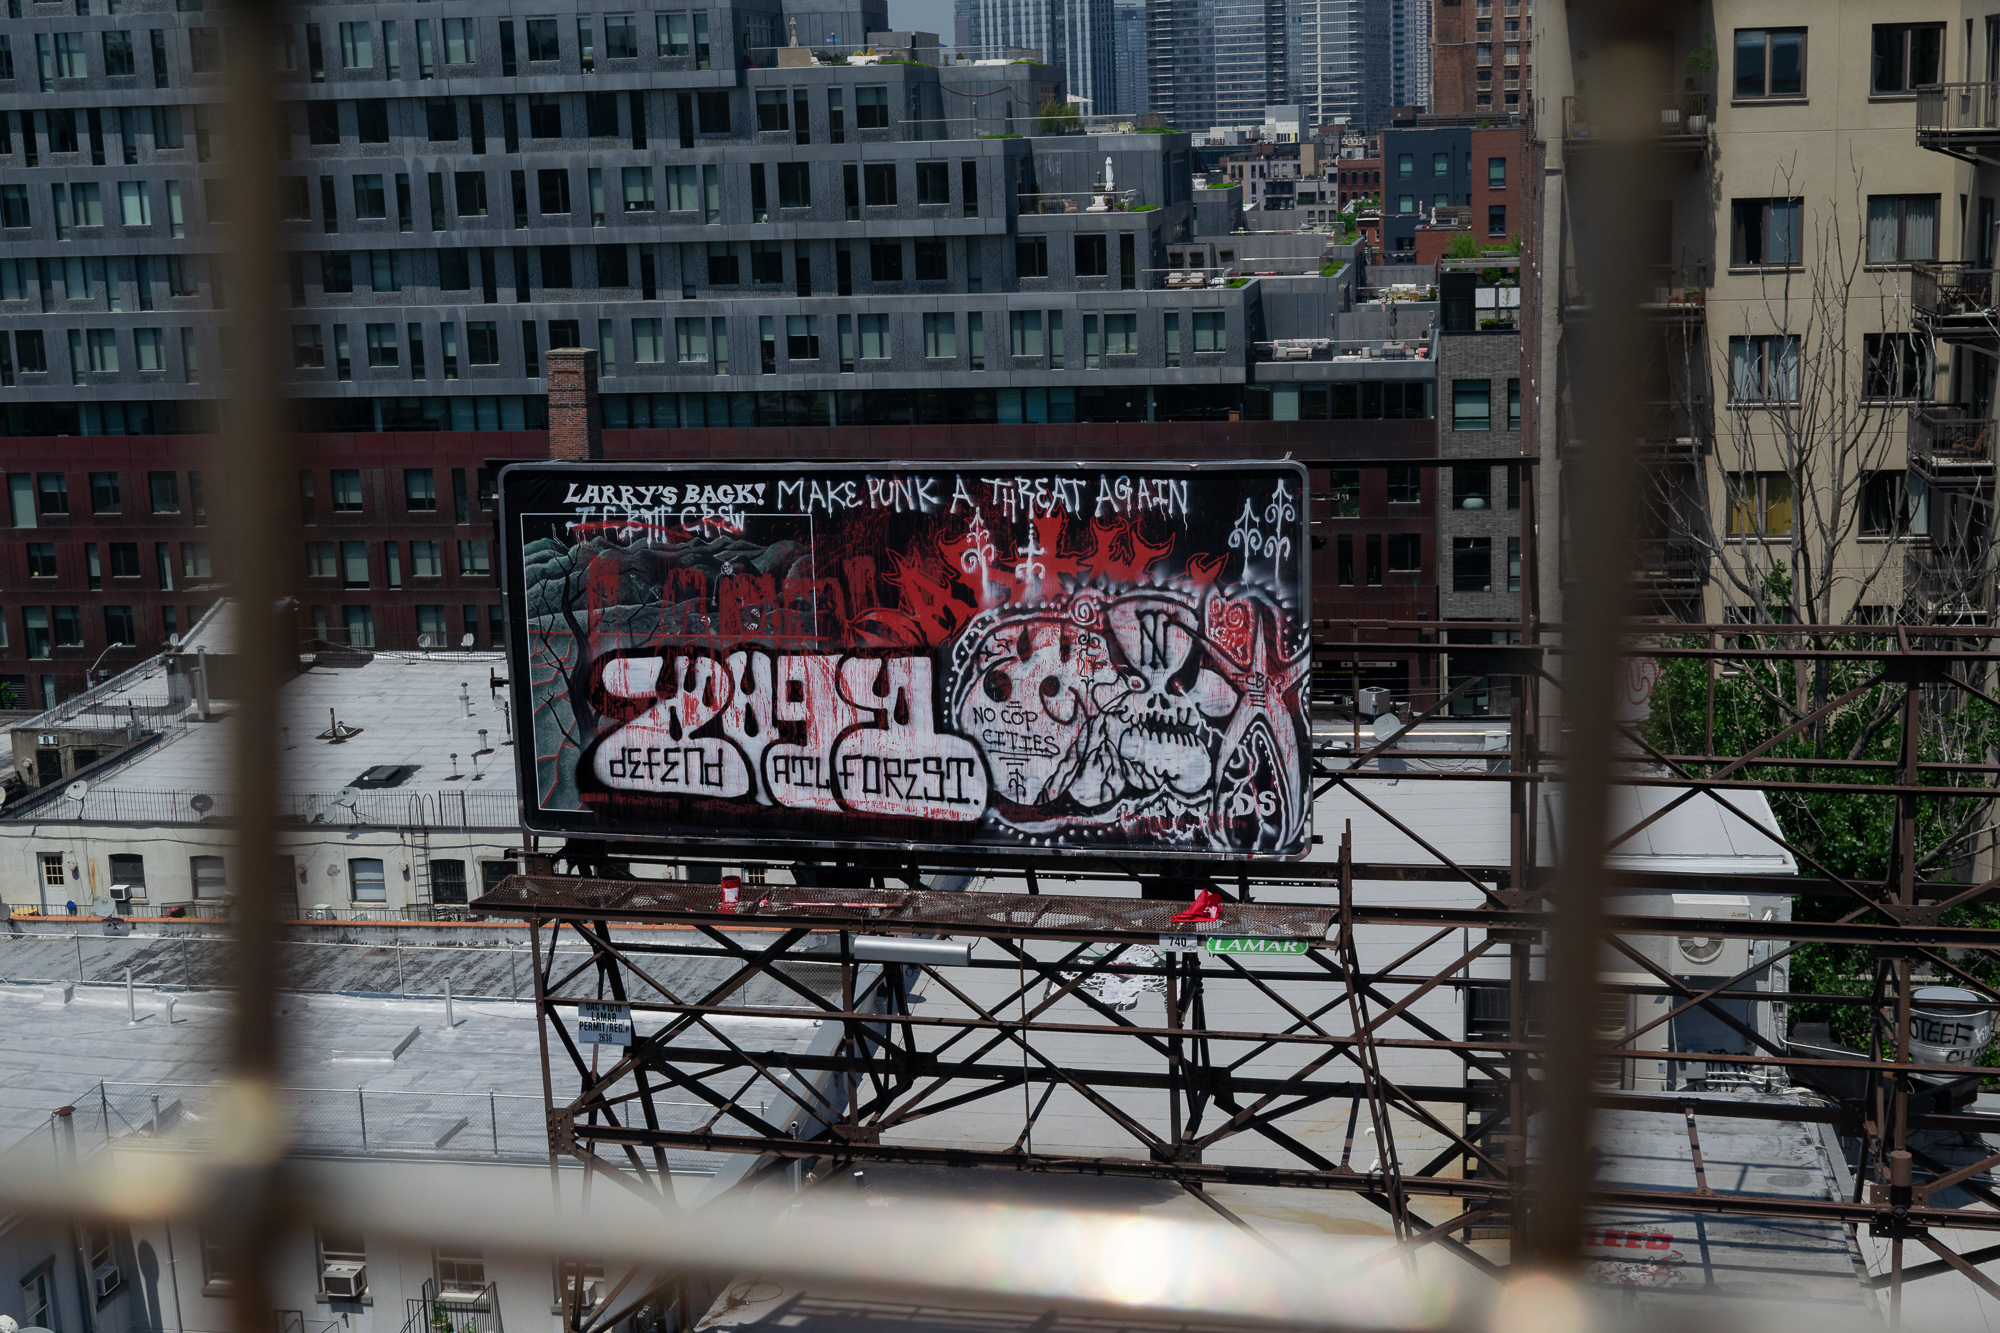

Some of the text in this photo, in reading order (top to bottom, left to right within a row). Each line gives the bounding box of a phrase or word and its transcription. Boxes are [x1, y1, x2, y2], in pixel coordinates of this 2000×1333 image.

[681, 483, 766, 505] BACK!
[777, 474, 1188, 521] MAKE PUNK A THREAT AGAIN
[973, 707, 1038, 731] NO COP
[983, 729, 1060, 755] CITIES
[1168, 937, 1187, 947] 740
[1214, 939, 1298, 953] LAMAR
[591, 1012, 617, 1022] LAMAR
[598, 1033, 612, 1043] 2636
